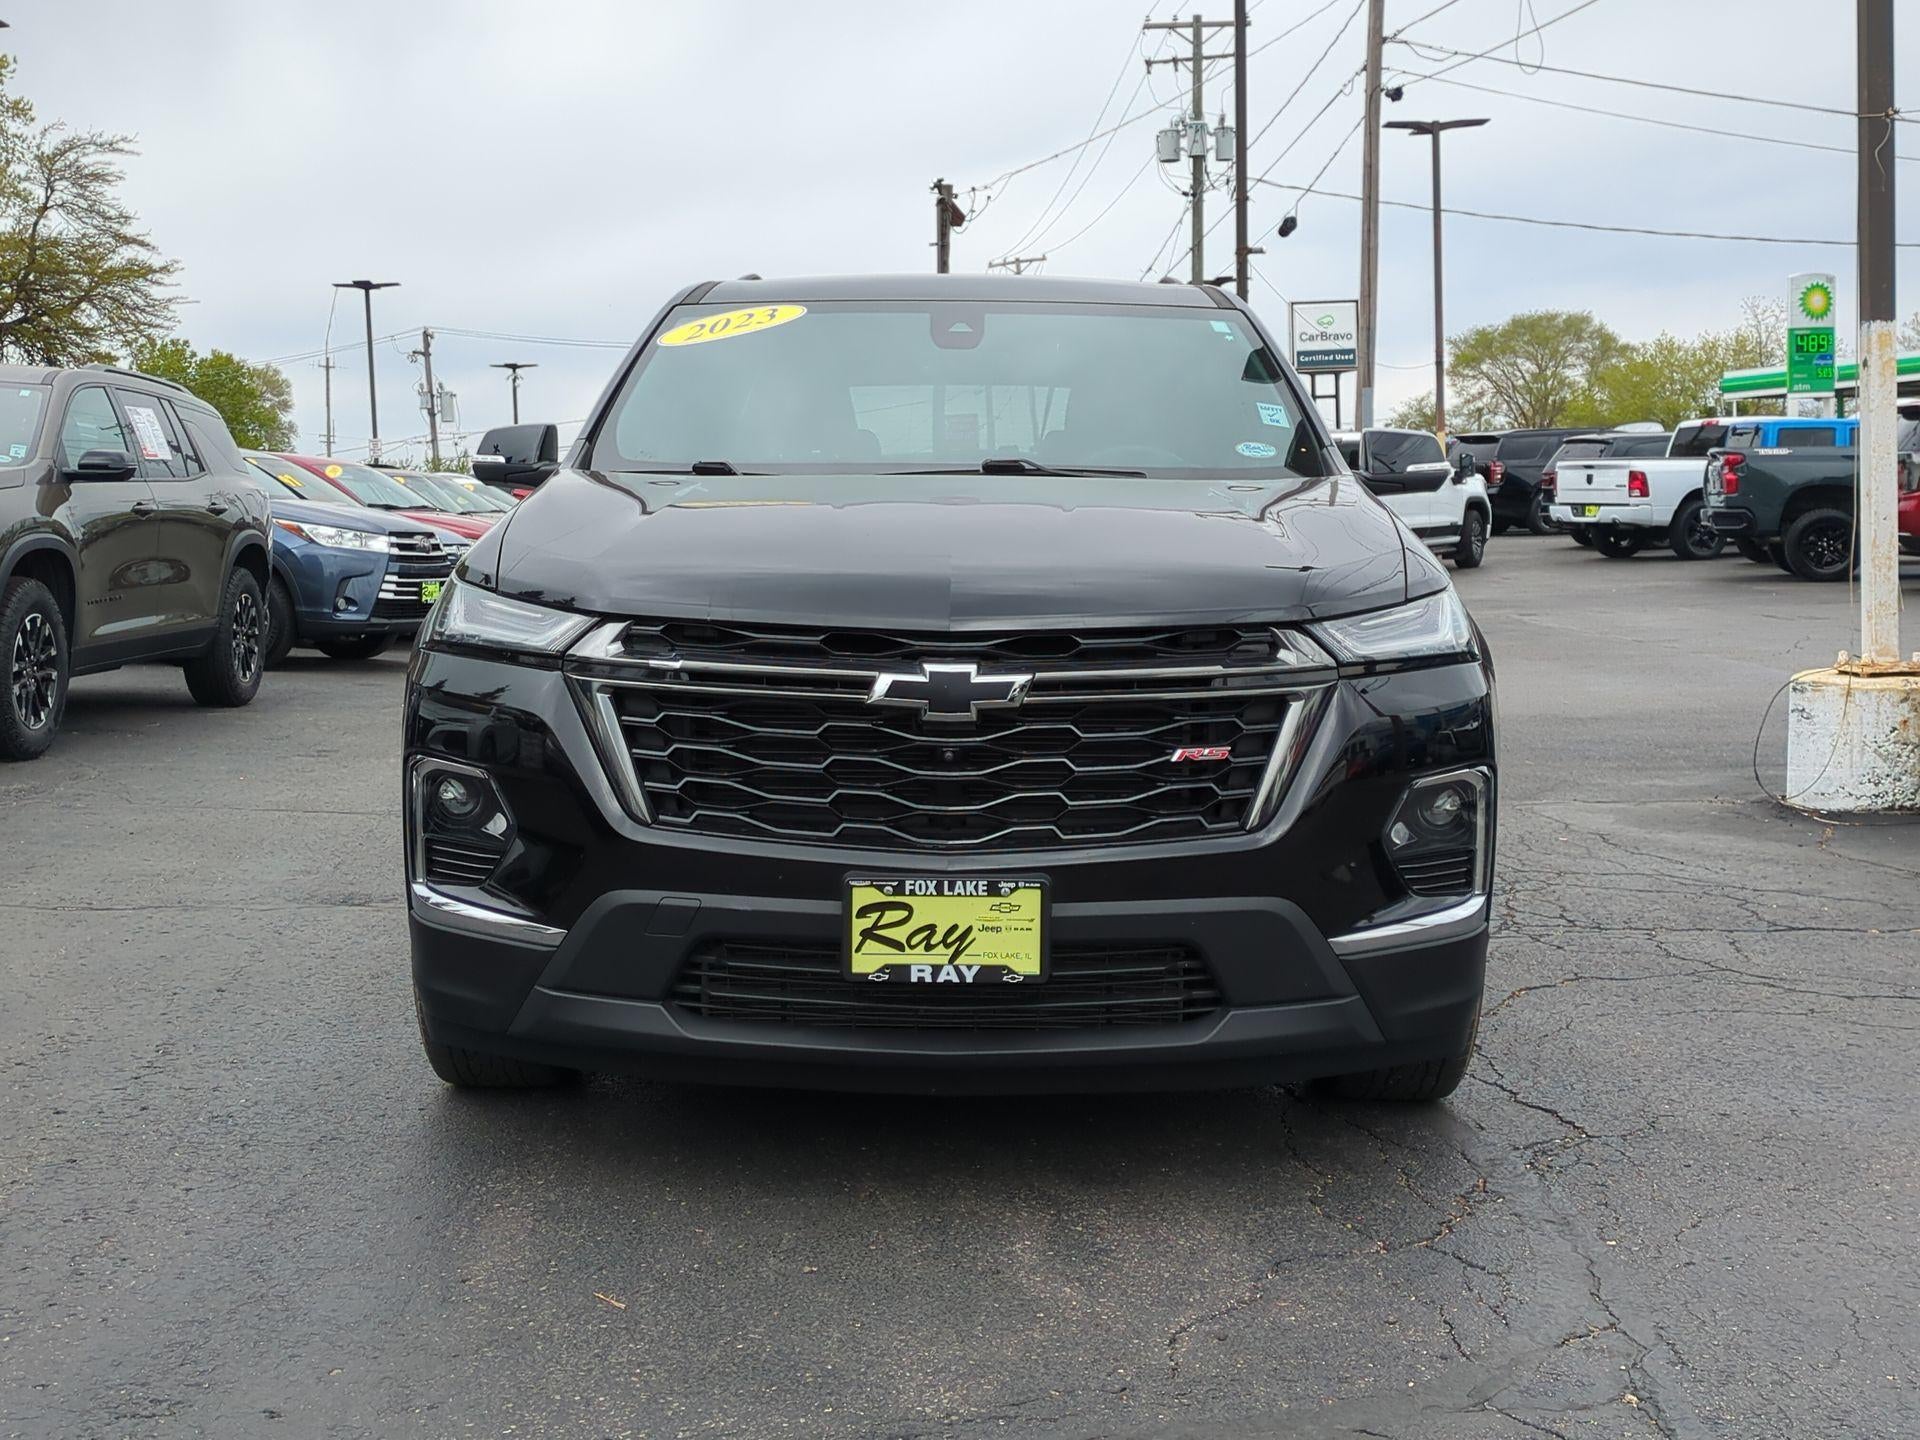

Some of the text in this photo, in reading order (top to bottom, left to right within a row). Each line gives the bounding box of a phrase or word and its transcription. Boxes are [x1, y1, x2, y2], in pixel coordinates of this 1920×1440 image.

[684, 308, 778, 341] 2023
[1299, 331, 1353, 342] CarBravo
[1797, 335, 1828, 352] 489
[1300, 353, 1354, 362] Certified Used
[1793, 383, 1811, 391] atm
[1171, 746, 1231, 762] RS
[905, 880, 988, 896] FOX LAKE
[998, 881, 1016, 889] Jeep
[854, 901, 976, 964] Ray
[978, 924, 1002, 934] Jeep
[910, 965, 981, 983] RAY
